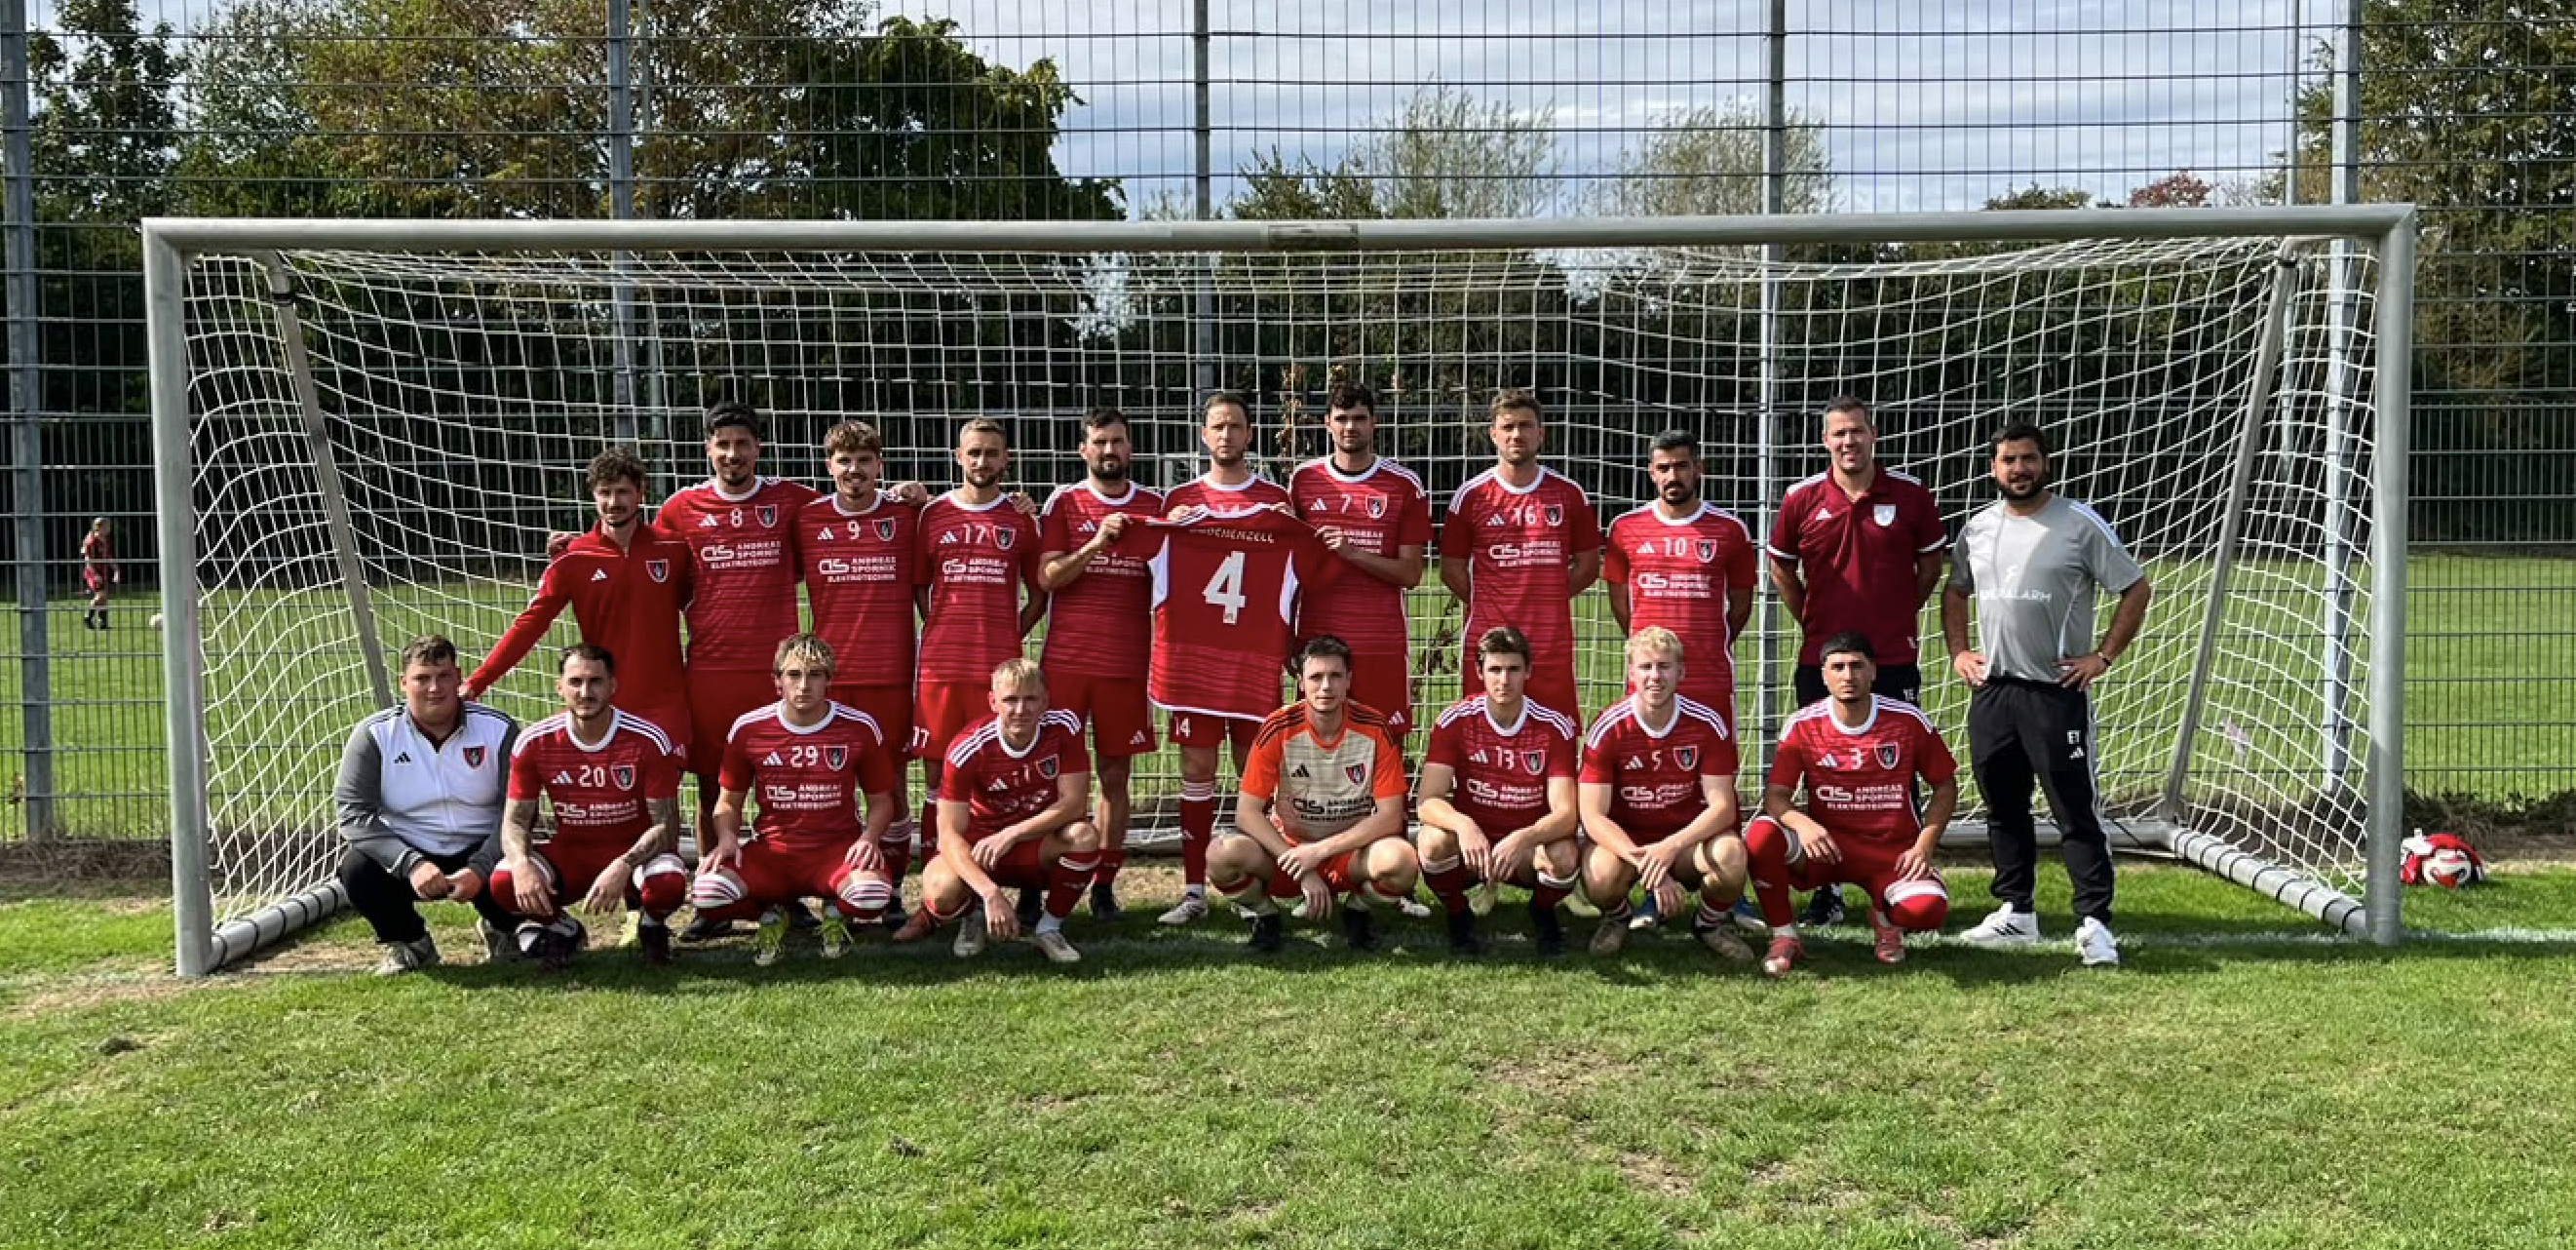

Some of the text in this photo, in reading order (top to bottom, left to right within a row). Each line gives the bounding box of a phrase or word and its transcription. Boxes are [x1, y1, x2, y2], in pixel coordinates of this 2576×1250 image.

[1340, 493, 1352, 514] 7
[730, 507, 743, 528] 8
[846, 519, 861, 541] 9
[961, 523, 987, 544] 17
[1663, 537, 1687, 559] 10
[1201, 551, 1247, 625] 4
[912, 725, 931, 749] 17
[1173, 717, 1192, 738] 14
[789, 746, 819, 768] 29
[1495, 747, 1515, 770] 13
[1651, 750, 1663, 771] 5
[1849, 748, 1863, 770] 3
[578, 764, 606, 788] 20
